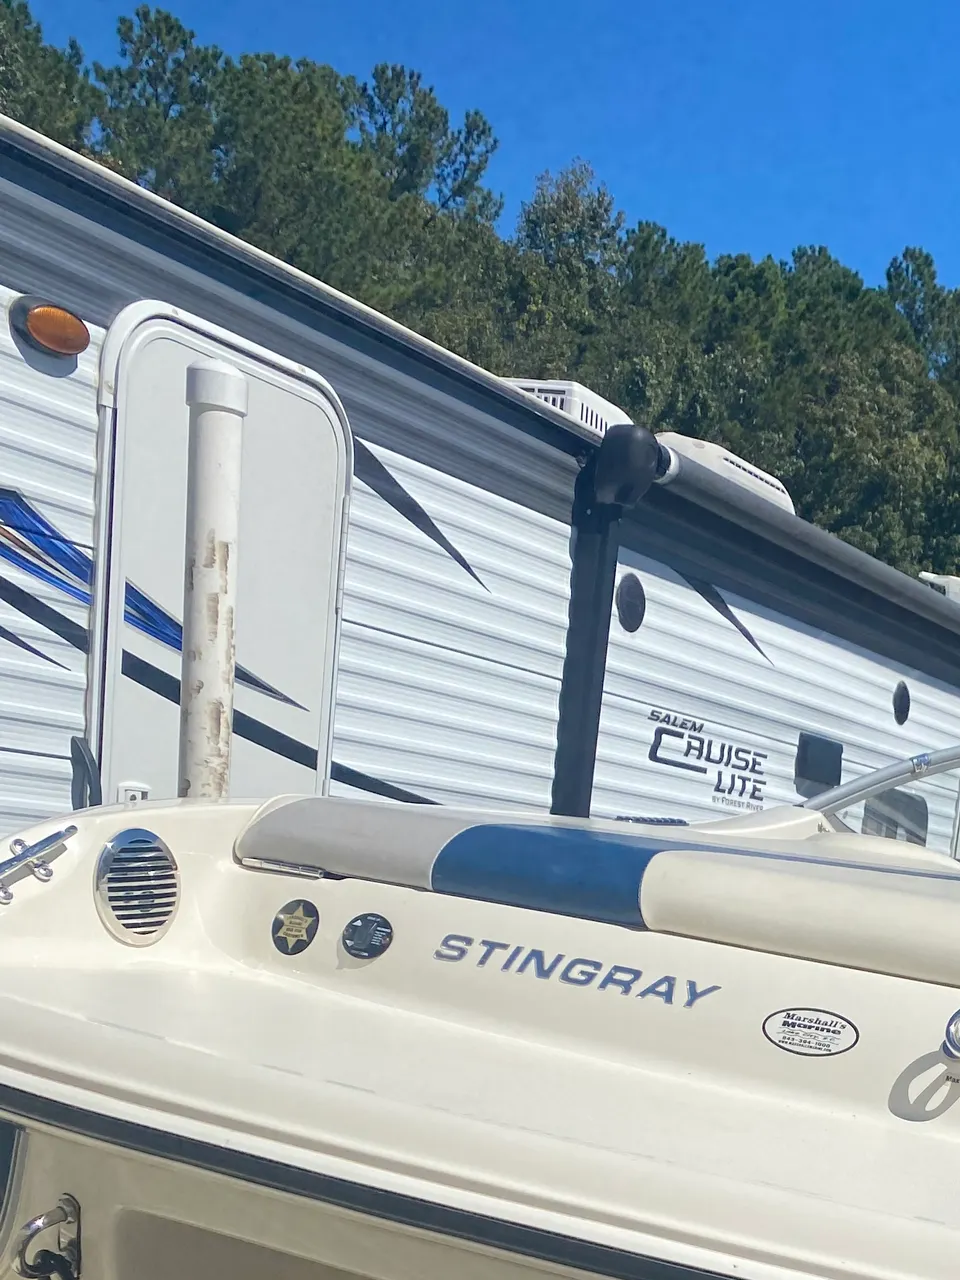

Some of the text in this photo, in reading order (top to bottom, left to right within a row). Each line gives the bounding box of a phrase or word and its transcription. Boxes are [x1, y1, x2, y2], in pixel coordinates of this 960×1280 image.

[647, 709, 704, 733] SALEM
[648, 726, 768, 775] CRUISE
[713, 770, 767, 801] LITE
[433, 934, 722, 1009] STINGRAY
[782, 1020, 842, 1035] Marine
[783, 1012, 847, 1030] Marshall's
[945, 1075, 959, 1084] Max
